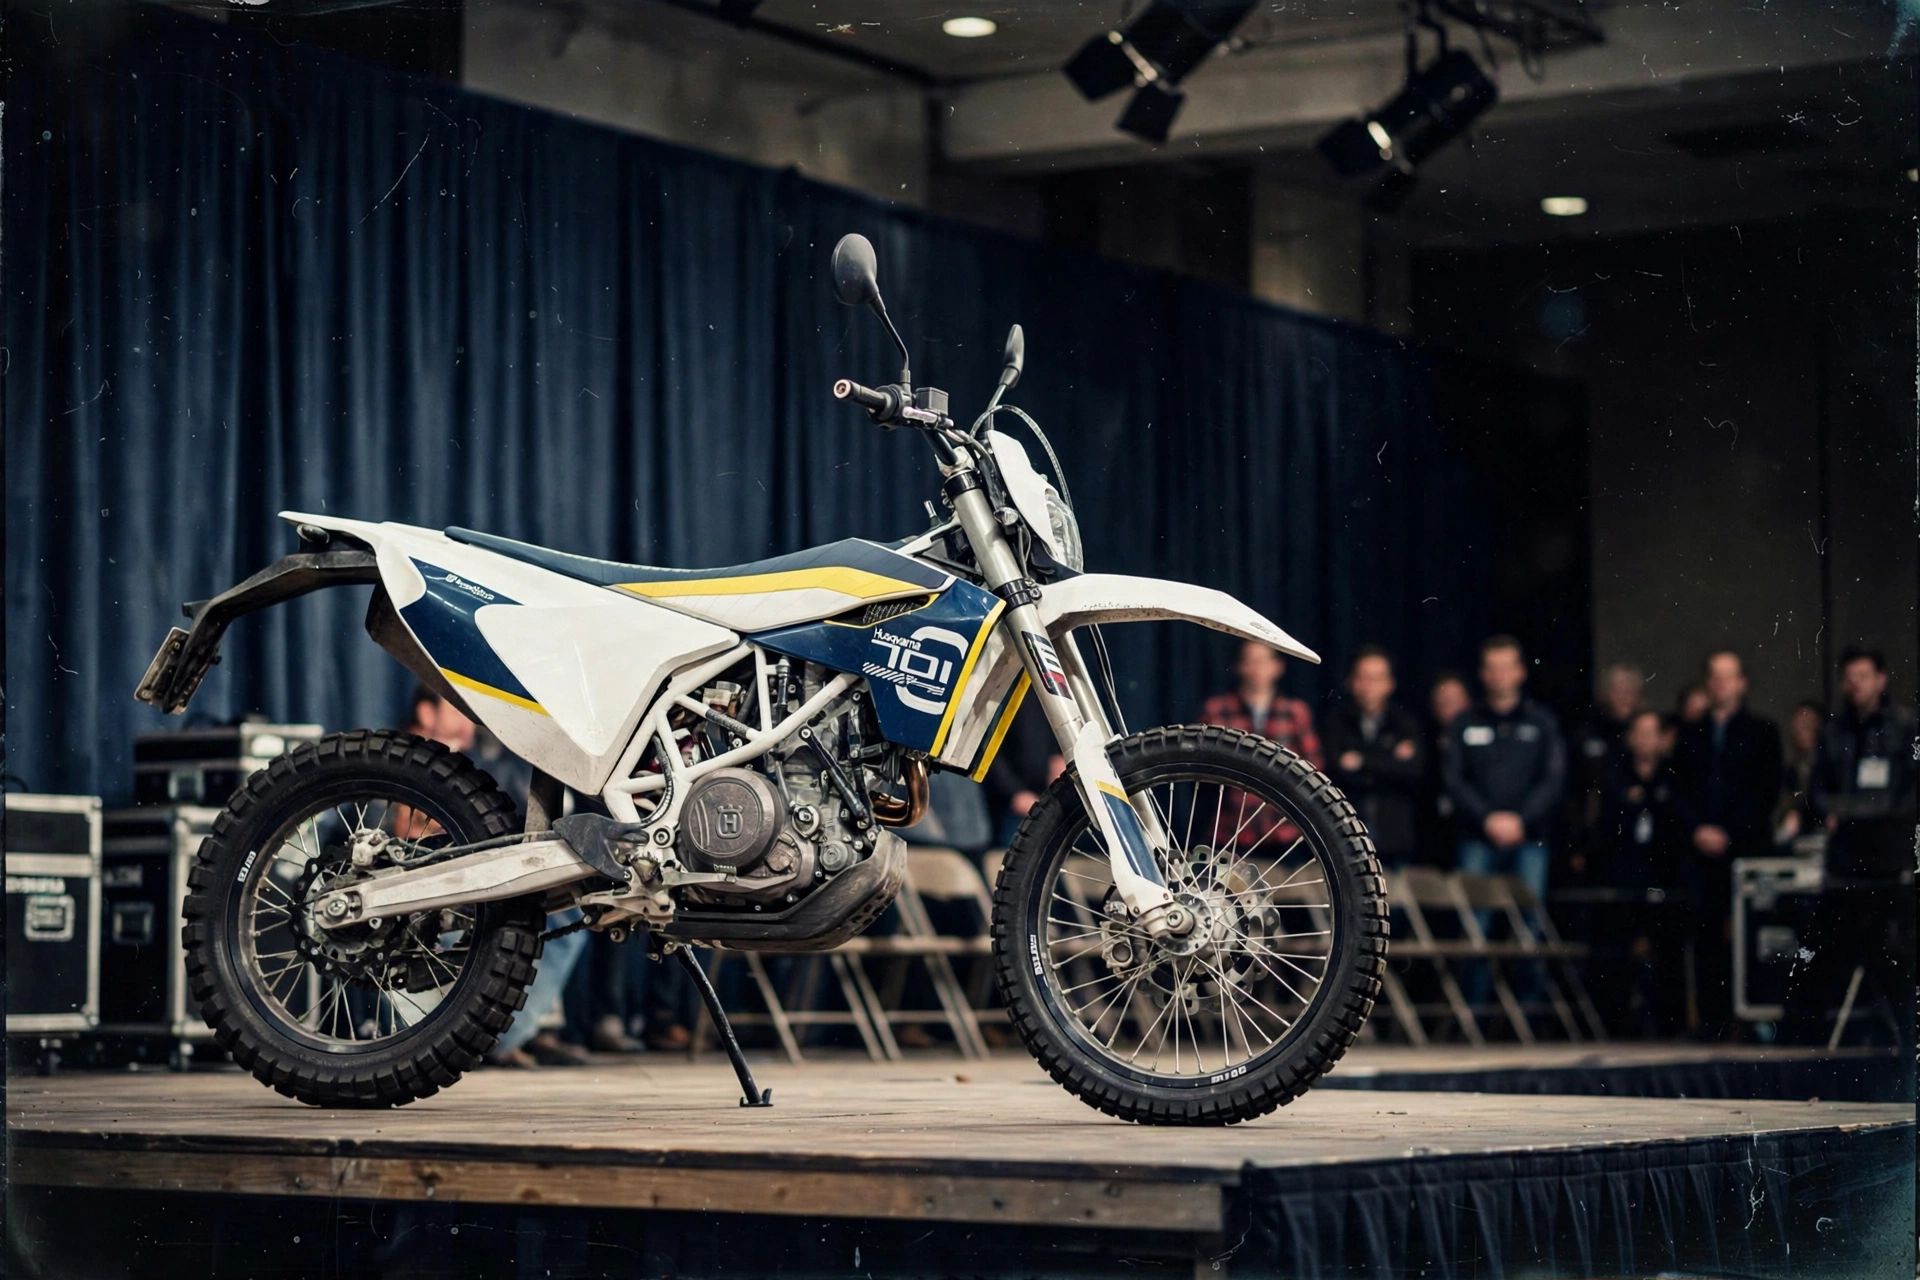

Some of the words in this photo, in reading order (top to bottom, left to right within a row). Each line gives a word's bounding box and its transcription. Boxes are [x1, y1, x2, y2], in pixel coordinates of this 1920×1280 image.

[873, 626, 922, 651] Husqvarna
[871, 639, 953, 684] 701
[723, 813, 738, 833] H
